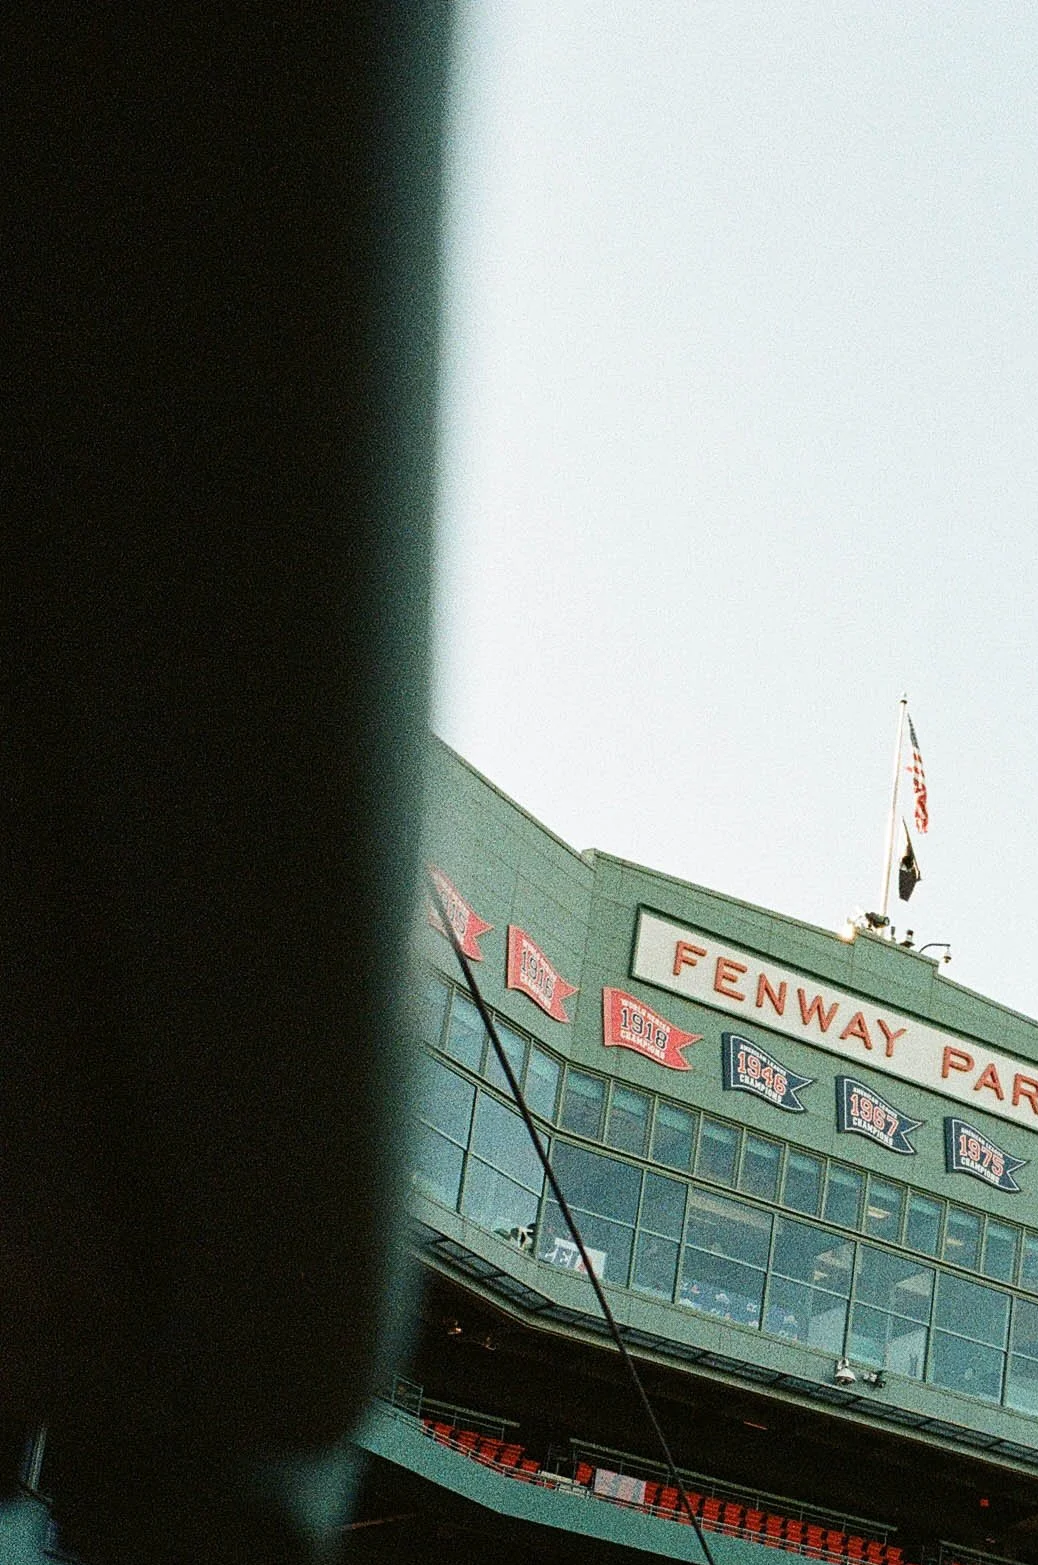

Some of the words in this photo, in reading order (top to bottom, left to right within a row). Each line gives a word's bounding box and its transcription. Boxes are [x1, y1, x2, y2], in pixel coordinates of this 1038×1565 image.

[672, 940, 907, 1058] FENWAY
[621, 1007, 668, 1051] 1918
[737, 1051, 788, 1096] 1946
[739, 1074, 782, 1104] CHAMPIONS
[850, 1093, 900, 1137] 1967
[852, 1117, 894, 1146] CHAMPIONS
[959, 1134, 1005, 1177] 1975
[960, 1156, 1000, 1184] CHAMPIONS
